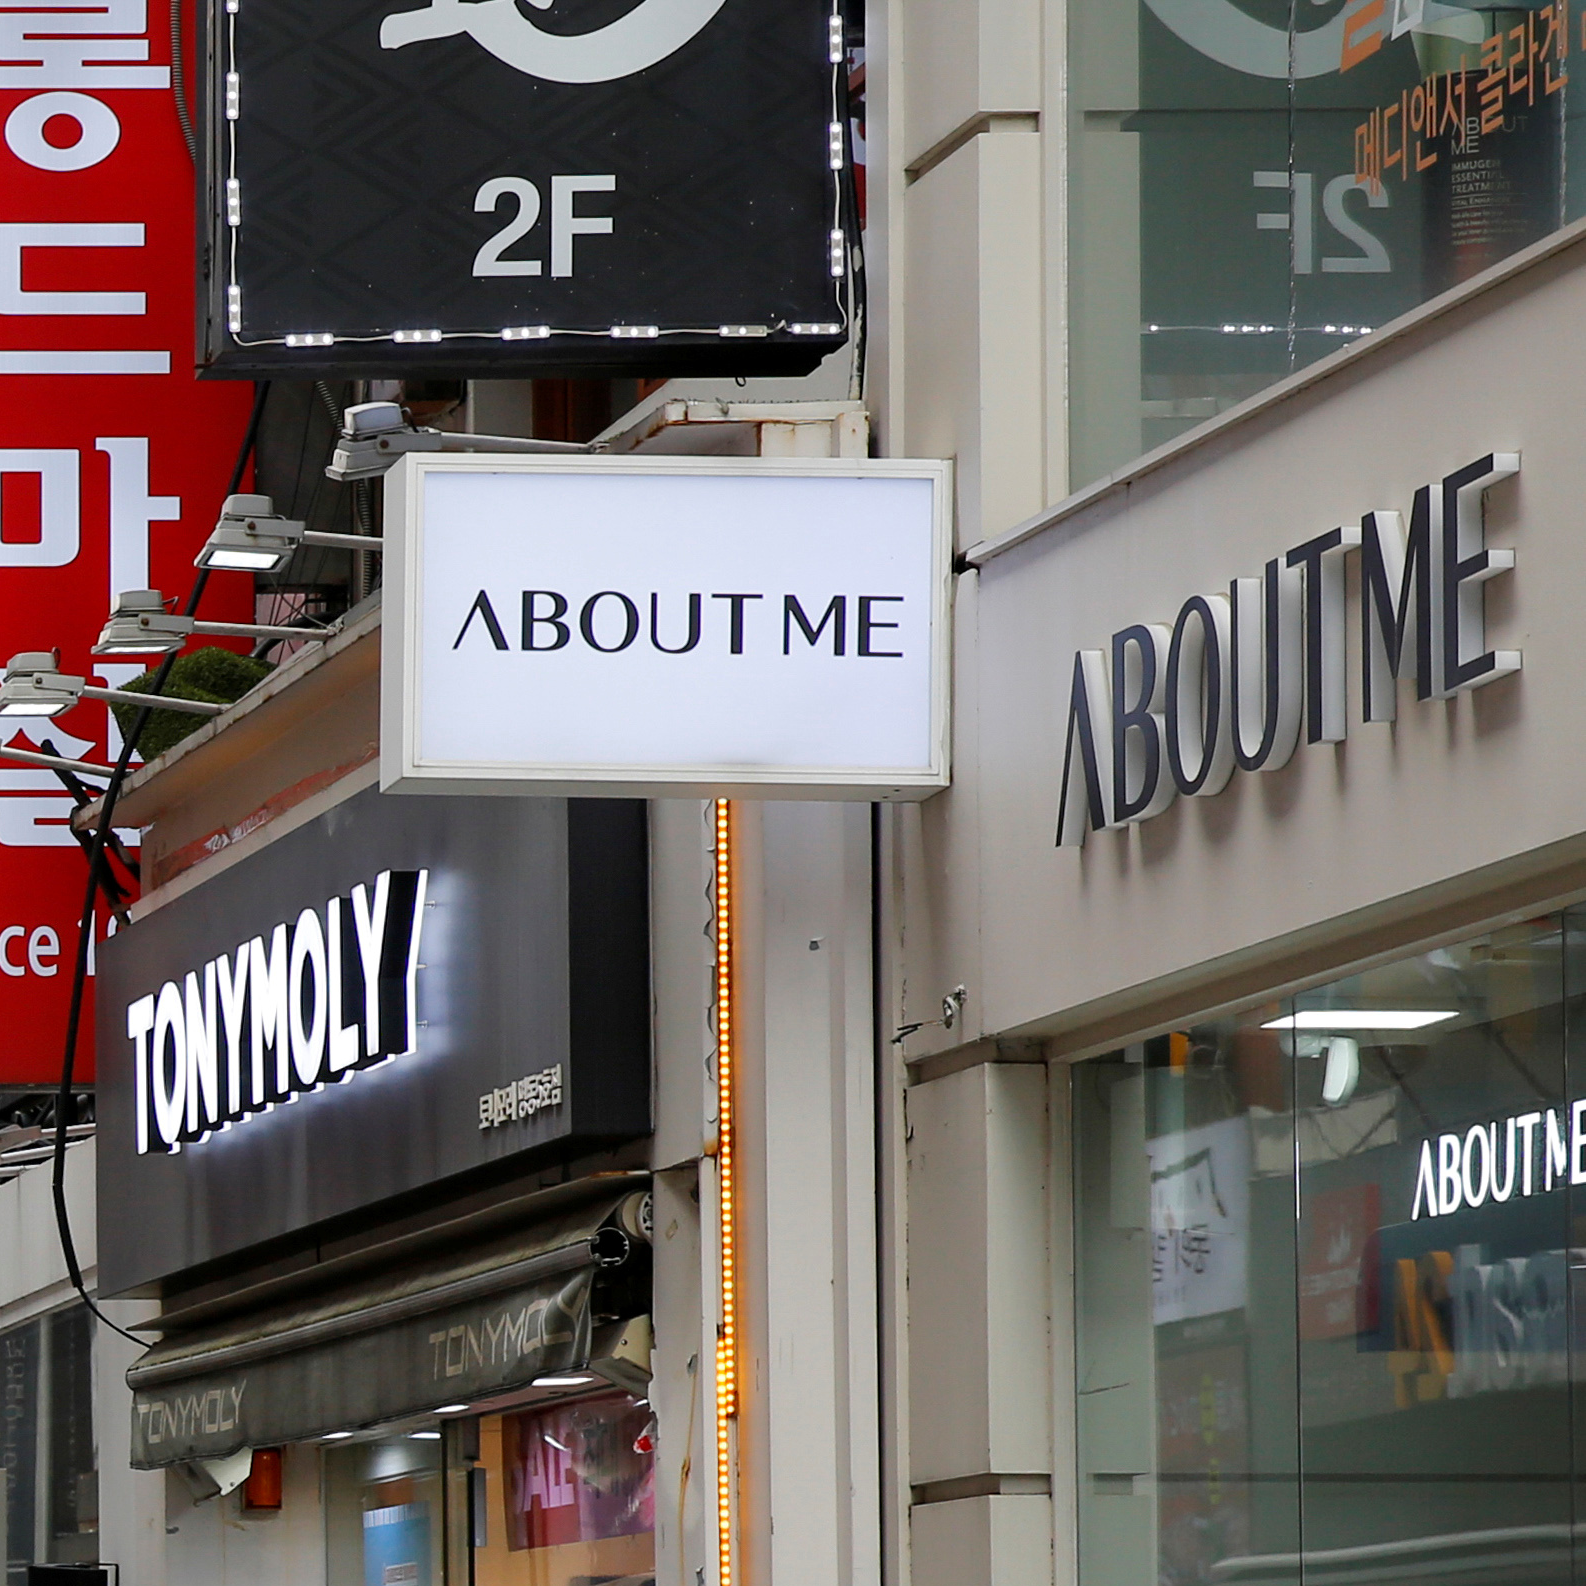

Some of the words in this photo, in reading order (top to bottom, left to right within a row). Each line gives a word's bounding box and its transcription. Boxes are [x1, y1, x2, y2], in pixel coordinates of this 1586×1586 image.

[471, 174, 617, 278] 2F
[452, 588, 763, 656] ABOUT
[782, 592, 905, 659] ME
[1055, 526, 1360, 848] ABOUT
[1360, 453, 1522, 723] ME
[126, 868, 429, 1155] TONYMOLY
[1412, 1109, 1541, 1221] ABOUT
